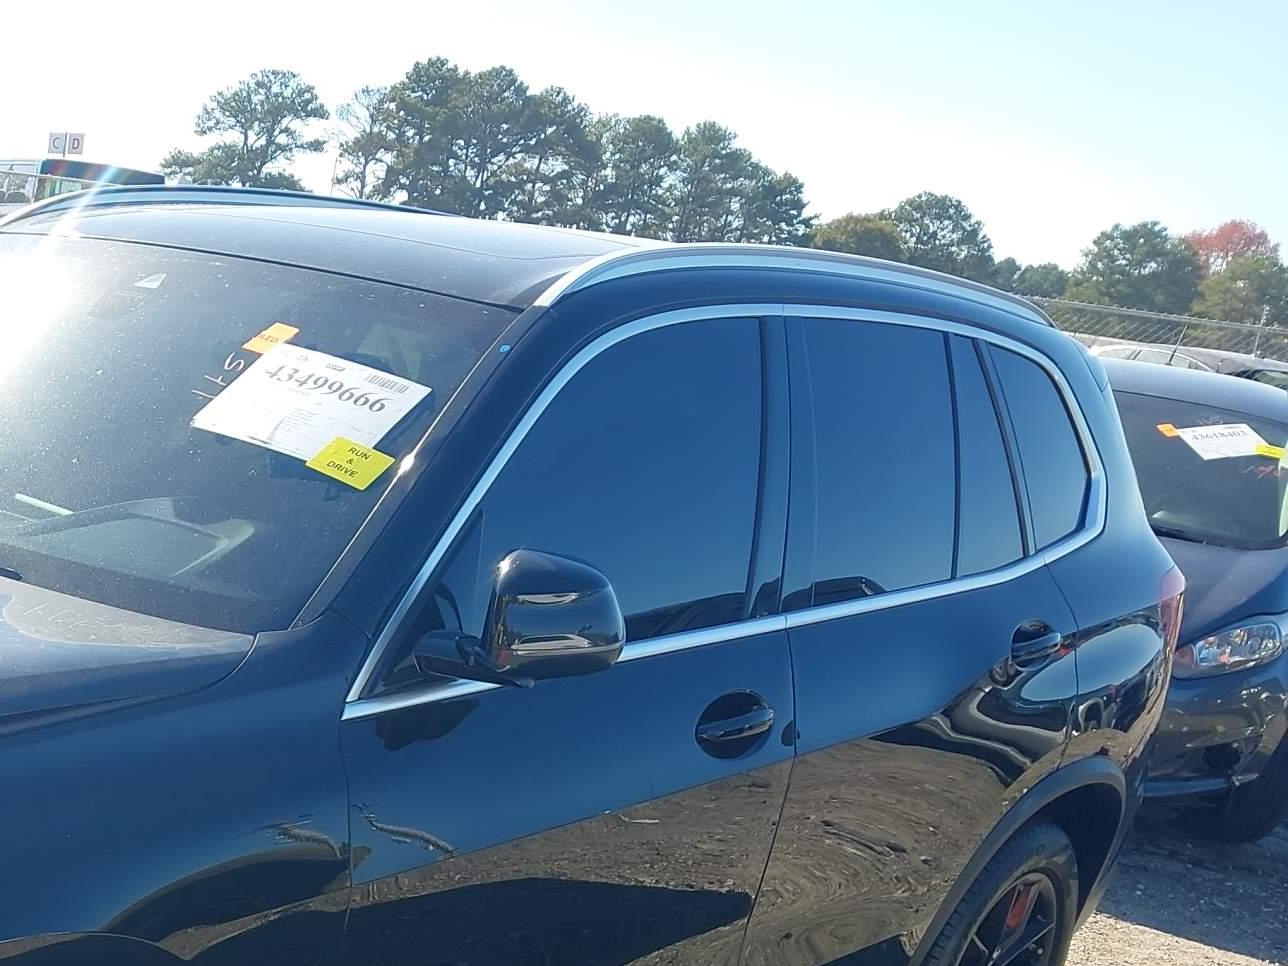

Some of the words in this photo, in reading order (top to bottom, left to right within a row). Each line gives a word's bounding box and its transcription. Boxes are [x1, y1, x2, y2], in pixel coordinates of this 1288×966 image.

[52, 136, 61, 150] C
[71, 137, 81, 150] D
[265, 364, 395, 414] 43499666
[347, 446, 372, 461] RUN
[345, 457, 355, 465] &
[326, 460, 359, 478] DRIVE
